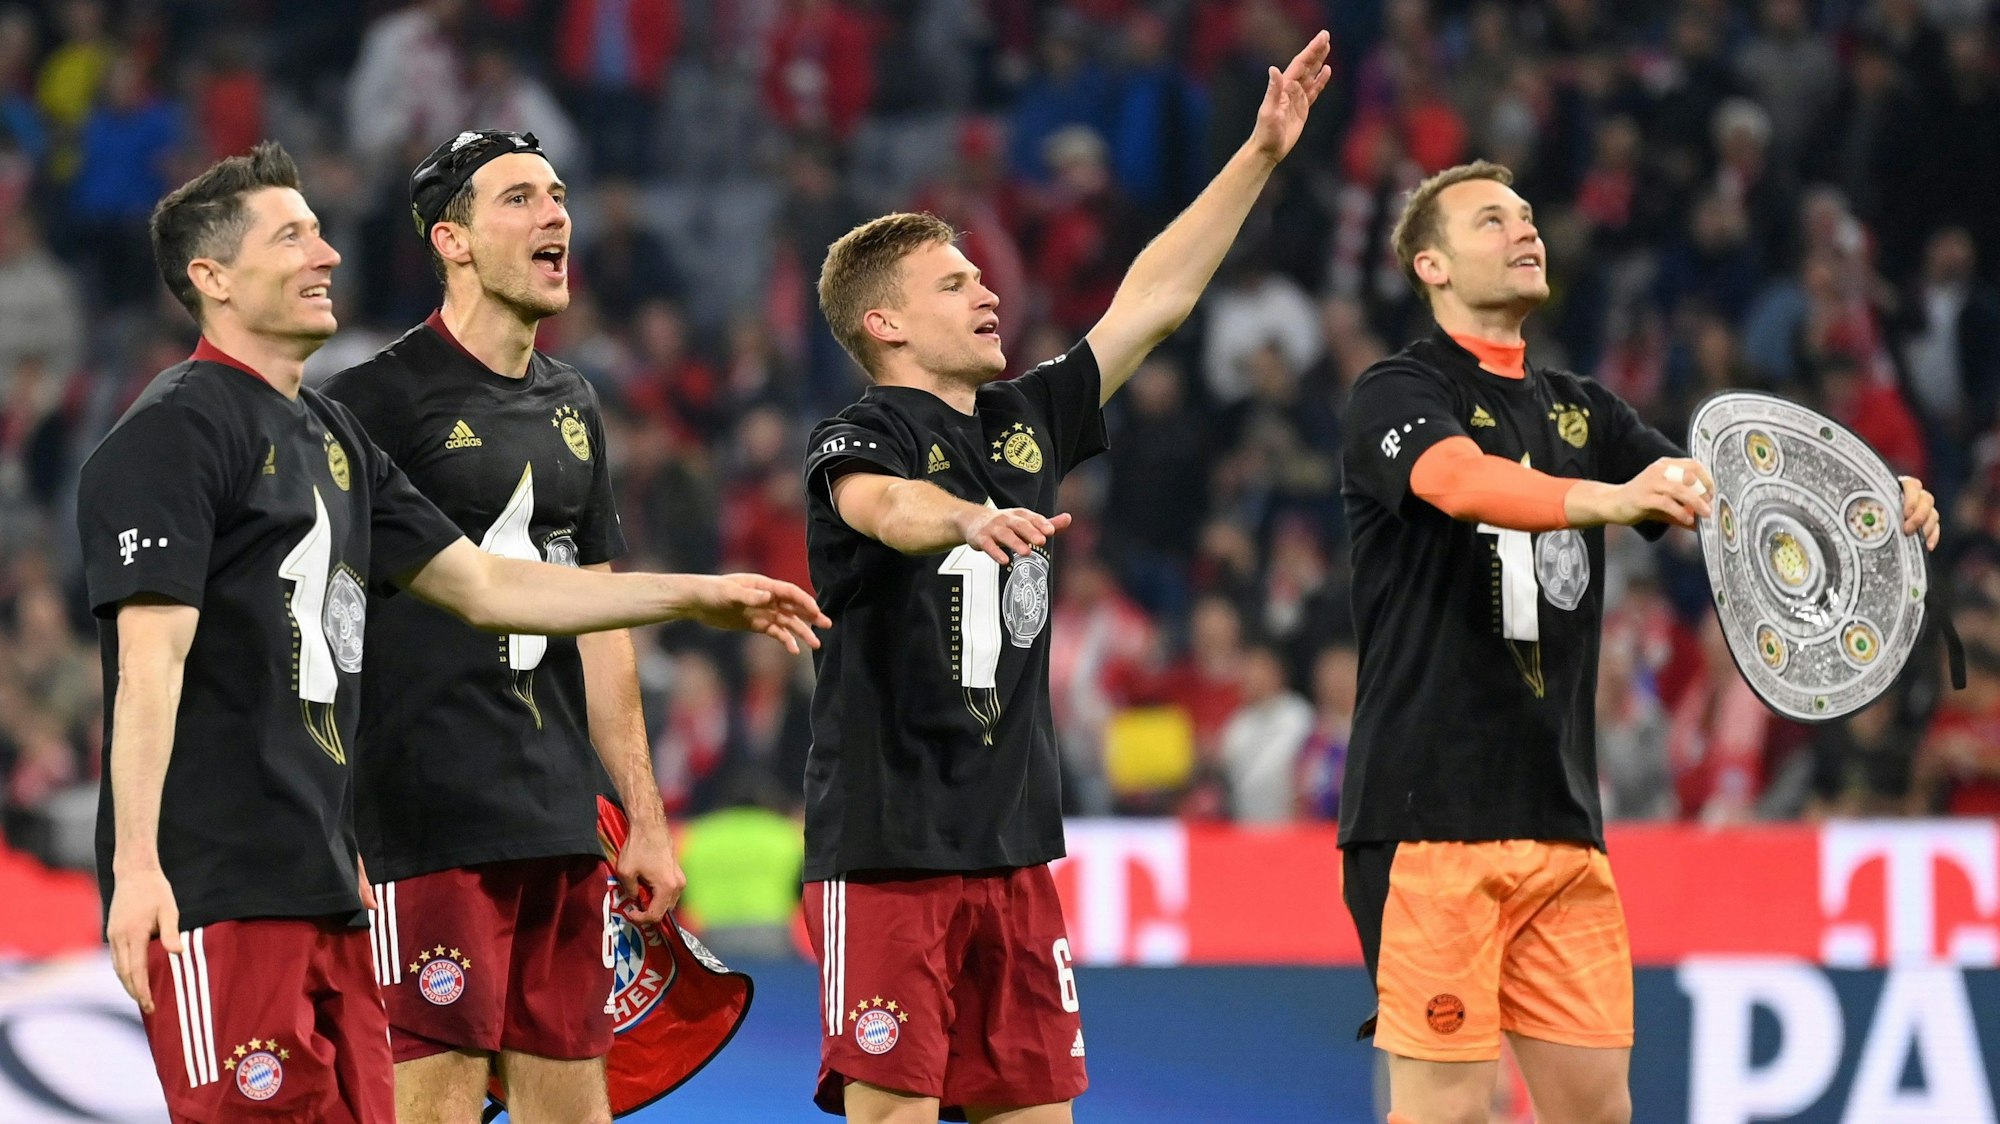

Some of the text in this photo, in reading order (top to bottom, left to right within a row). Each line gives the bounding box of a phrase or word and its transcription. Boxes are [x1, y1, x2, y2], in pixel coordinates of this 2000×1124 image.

[445, 437, 482, 450] adidas
[927, 460, 951, 474] didas
[423, 962, 461, 980] FC BAYERN
[1053, 938, 1079, 1013] 6
[859, 1013, 896, 1030] FC BAYERN
